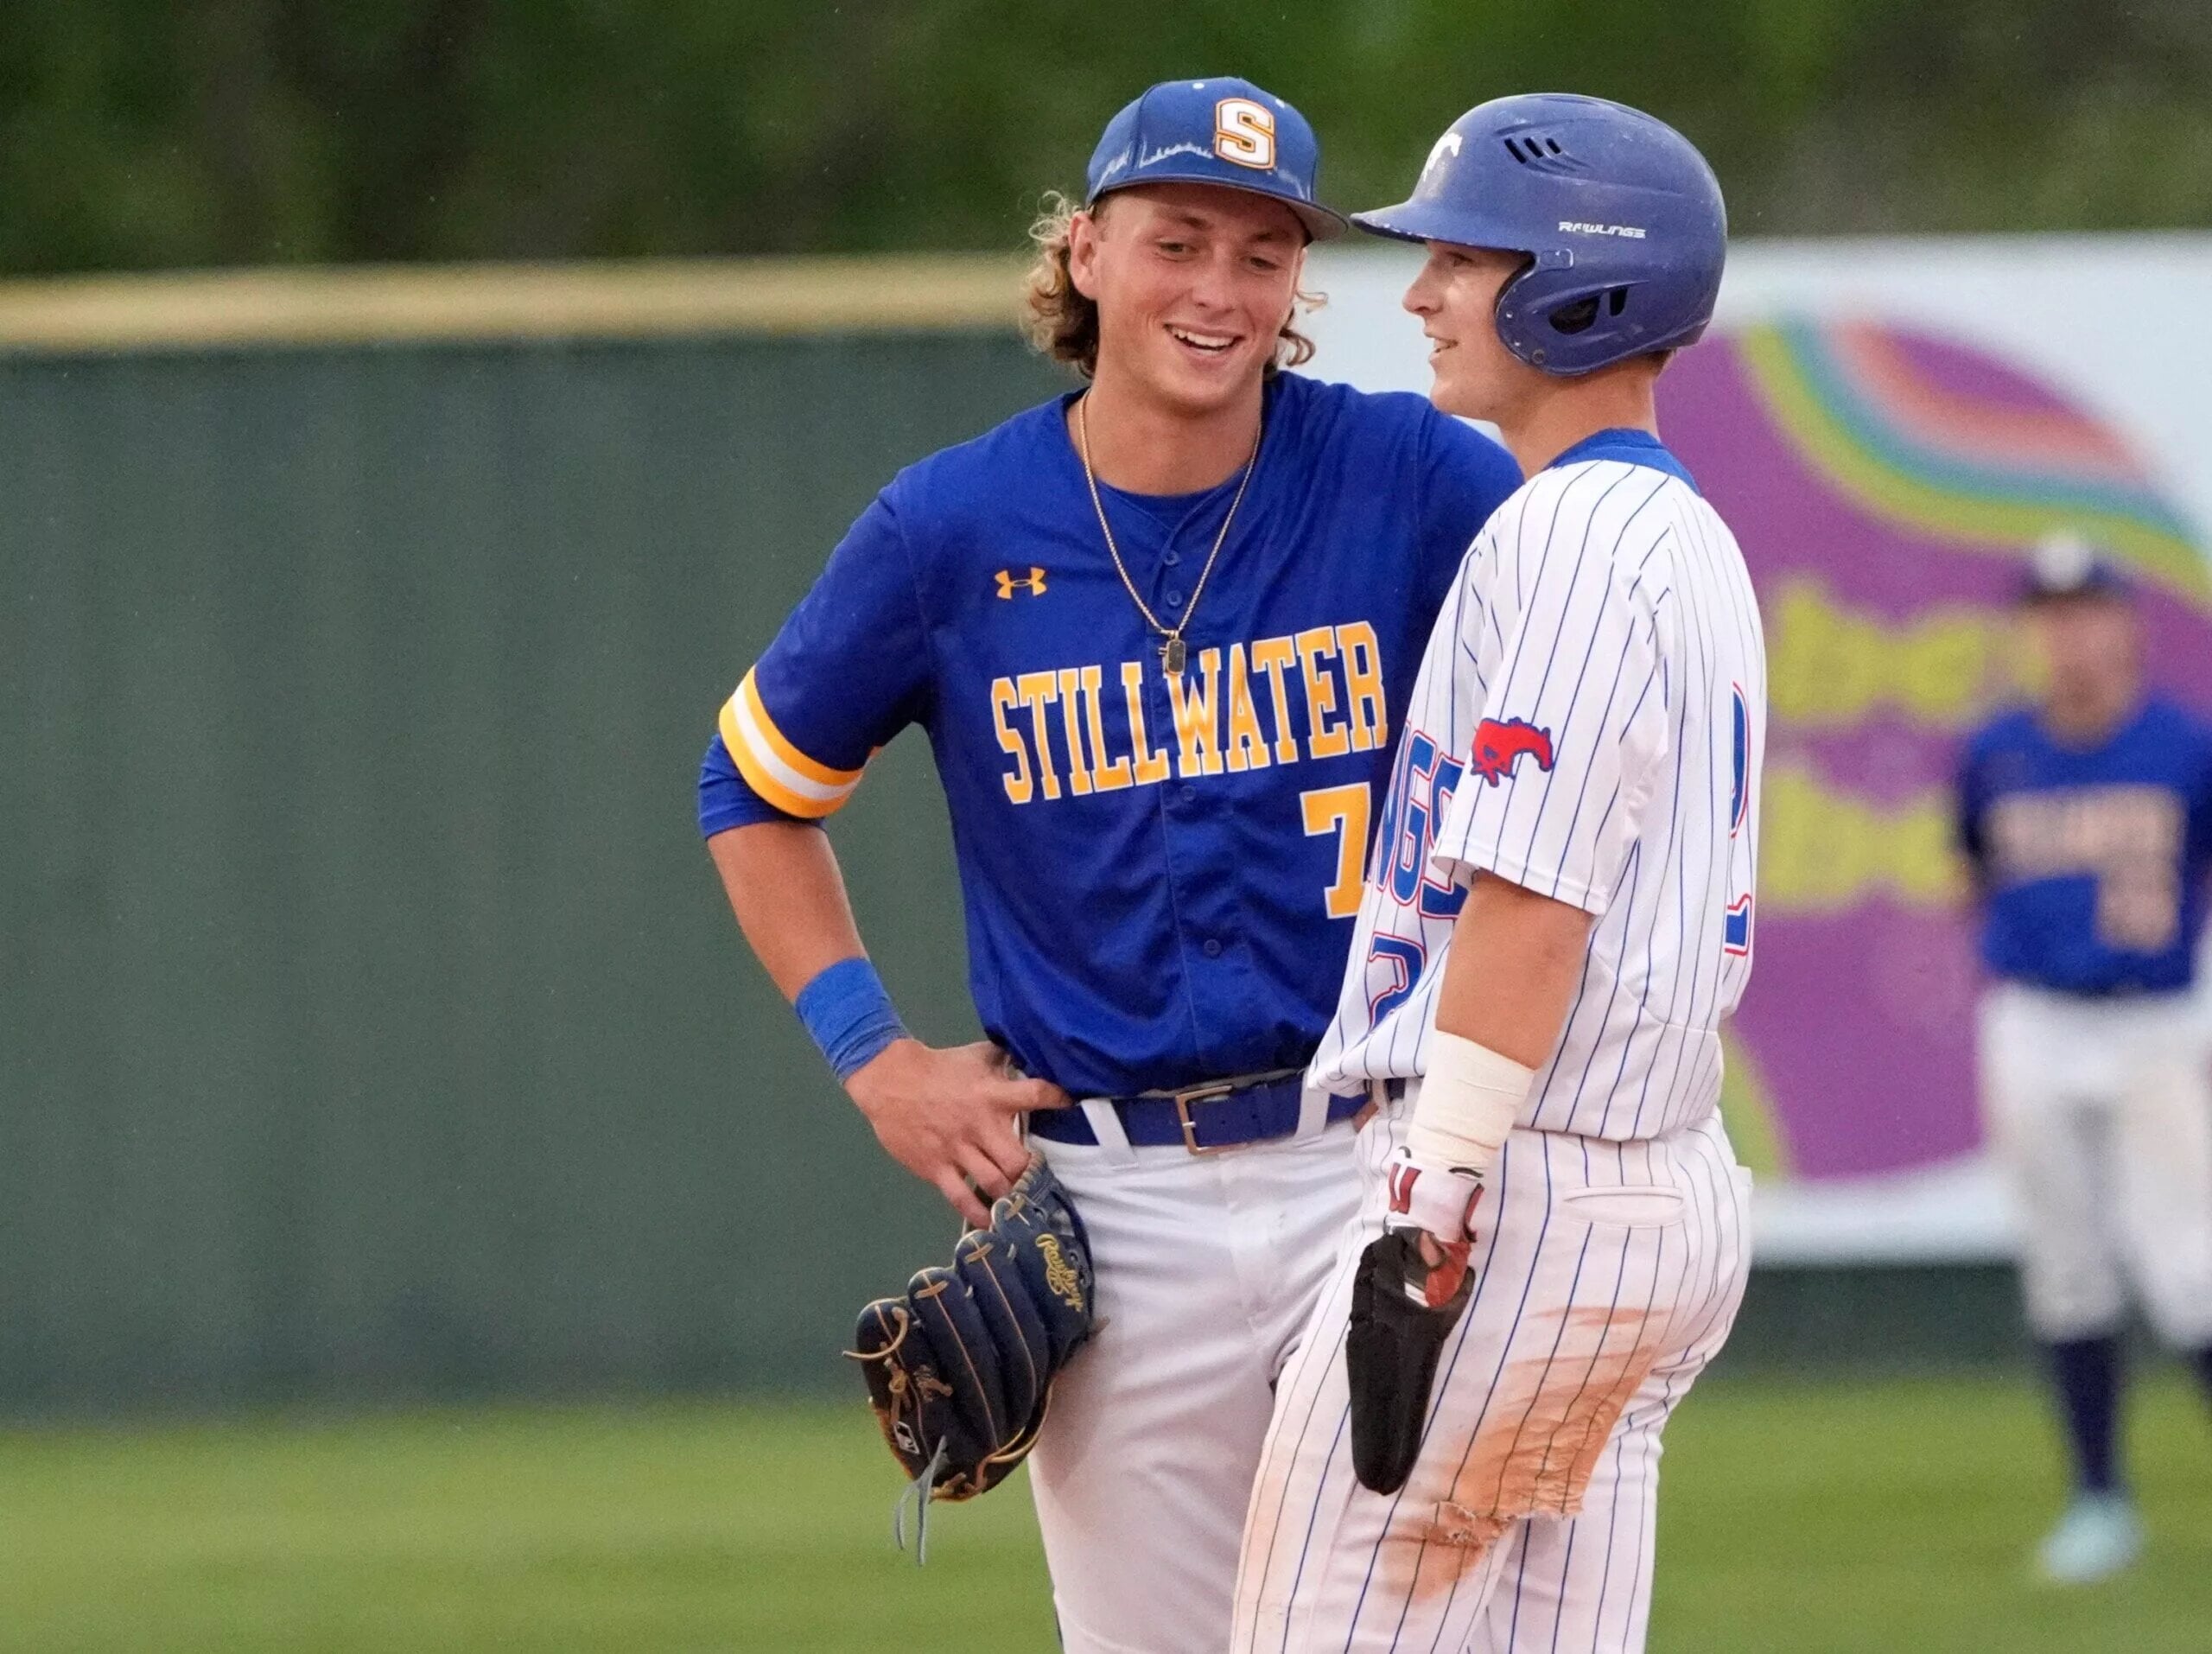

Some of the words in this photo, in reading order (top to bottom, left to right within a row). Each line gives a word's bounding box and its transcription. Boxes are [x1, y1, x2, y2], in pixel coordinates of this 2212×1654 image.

[1215, 98, 1275, 170] S
[1558, 221, 1646, 239] RAWLINGS
[991, 620, 1388, 805] STILLWATER
[1300, 781, 1371, 919] 7
